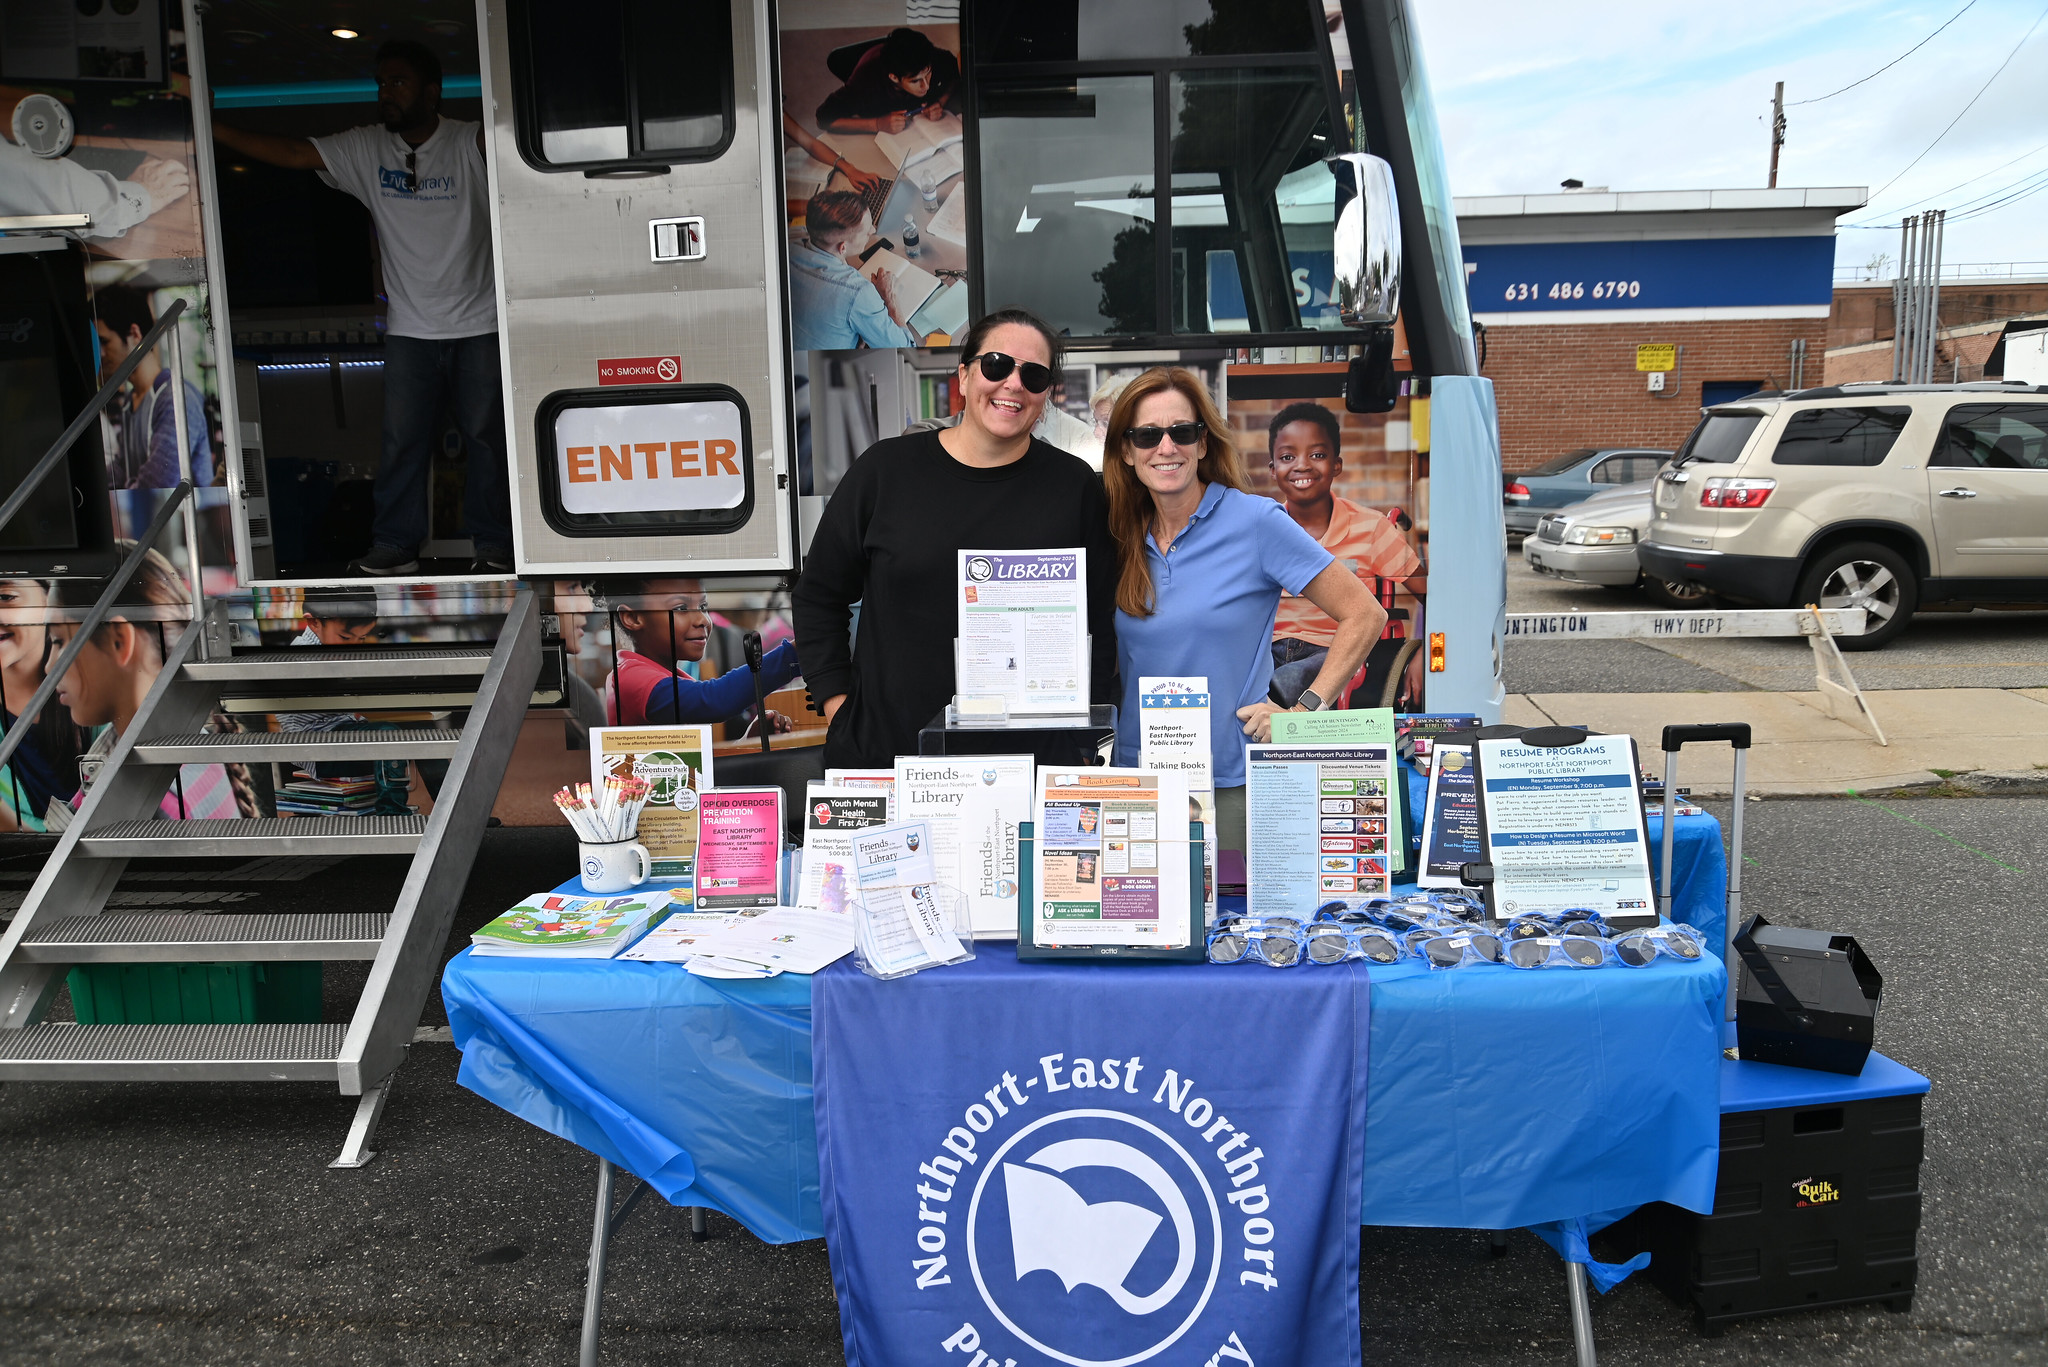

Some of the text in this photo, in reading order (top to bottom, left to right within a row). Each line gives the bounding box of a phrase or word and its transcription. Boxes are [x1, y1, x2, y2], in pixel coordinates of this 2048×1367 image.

[1504, 280, 1640, 301] 631 486 6790
[601, 366, 656, 376] NO SMOKING
[566, 439, 740, 484] ENTER
[998, 562, 1075, 579] LIBRARY
[1504, 616, 1588, 636] UNTINGTON
[1654, 618, 1724, 634] HWY DEPT
[1150, 682, 1166, 694] PROUD
[1500, 746, 1606, 758] RESUME PROGRAMS
[905, 768, 959, 780] Friends
[911, 791, 963, 806] Library
[860, 839, 888, 852] Friends
[1002, 822, 1019, 876] Library
[869, 852, 897, 864] Library
[979, 842, 993, 897] Friends
[542, 897, 634, 912] LEAP
[923, 884, 941, 922] Friends
[916, 902, 935, 937] Library
[486, 932, 534, 942] COLORING
[912, 1052, 1278, 1292] Northport-East Northport
[1792, 1176, 1812, 1188] Original
[1799, 1181, 1832, 1196] Quik
[1809, 1189, 1839, 1203] Cart
